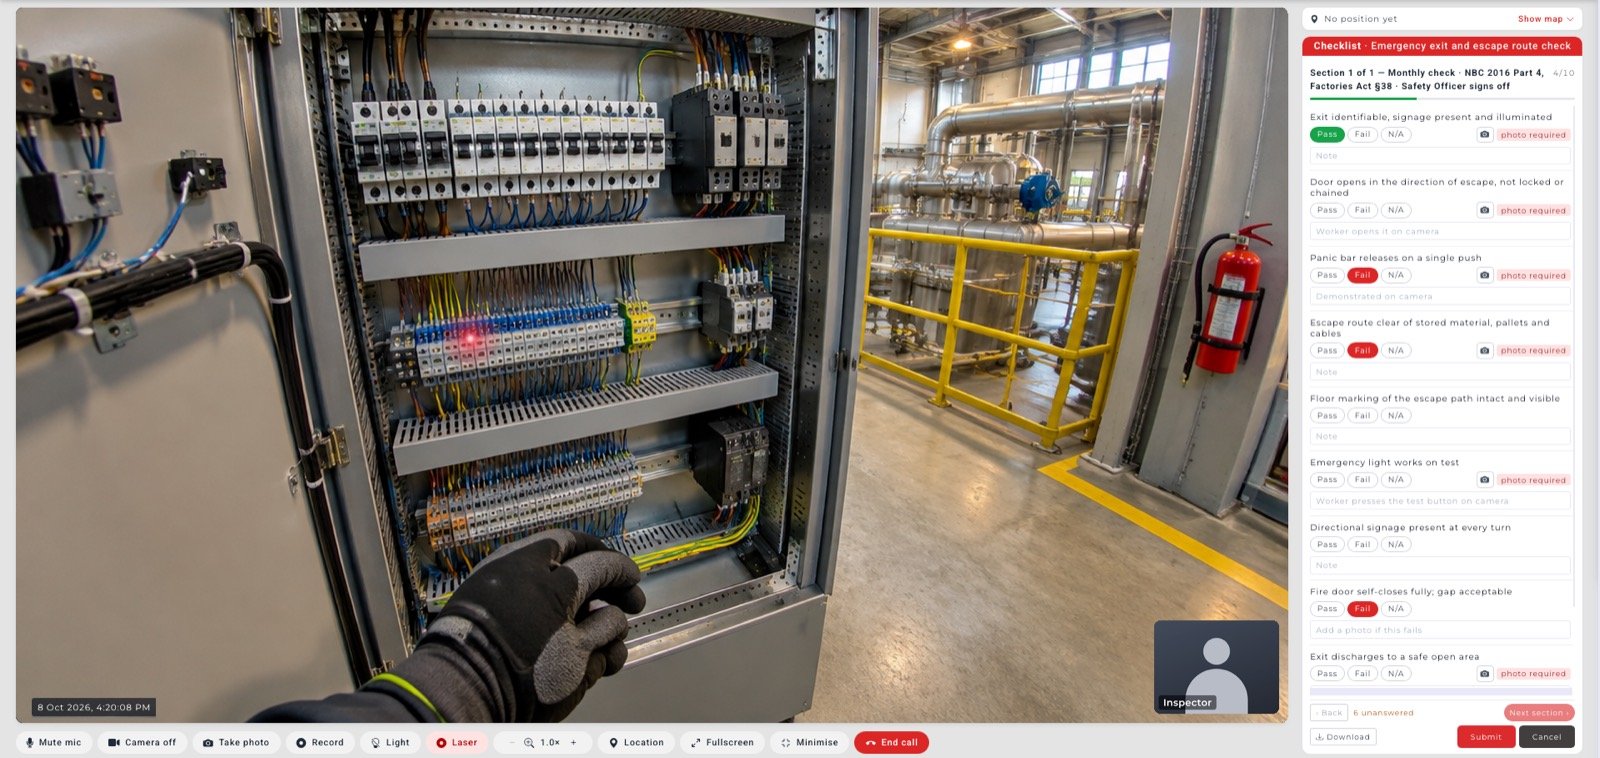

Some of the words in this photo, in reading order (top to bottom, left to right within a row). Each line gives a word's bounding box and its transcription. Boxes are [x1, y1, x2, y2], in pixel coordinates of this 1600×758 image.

[1324, 15, 1338, 23] No
[1340, 14, 1380, 24] position
[1382, 15, 1398, 25] yet
[1518, 14, 1542, 23] Show
[1544, 16, 1563, 24] map
[1313, 40, 1362, 51] Checklist
[1370, 40, 1427, 53] Emergency
[1429, 41, 1448, 51] exit
[1451, 41, 1470, 50] and
[1472, 42, 1509, 53] escape
[1511, 42, 1539, 51] route
[1541, 41, 1572, 50] check
[1310, 68, 1345, 77] Section
[1348, 68, 1353, 77] 1
[1356, 68, 1367, 77] of
[1369, 68, 1374, 77] 1
[1387, 68, 1426, 79] Monthly
[1427, 68, 1456, 77] check
[1464, 68, 1485, 77] NBC
[1487, 68, 1511, 77] 2016
[1513, 68, 1533, 77] Part
[1535, 68, 1544, 78] 4,
[1552, 68, 1575, 78] 4/10
[1310, 81, 1353, 91] Factories
[1355, 81, 1372, 90] Act
[1374, 82, 1393, 93] §38
[1401, 81, 1432, 92] Safety
[1433, 81, 1467, 90] Officer
[1469, 82, 1494, 92] signs
[1496, 81, 1511, 90] off
[1310, 112, 1329, 121] Exit
[1331, 112, 1390, 122] identifiable,
[1392, 112, 1432, 123] signage
[1434, 113, 1472, 123] present
[1474, 113, 1494, 121] and
[1496, 112, 1553, 121] illuminated
[1317, 130, 1338, 138] Pass
[1355, 130, 1371, 138] Fail
[1388, 130, 1405, 138] N/A
[1500, 131, 1527, 140] photo
[1529, 131, 1567, 140] required
[1310, 178, 1334, 186] Door
[1336, 179, 1367, 188] opens
[1369, 177, 1379, 186] in
[1381, 178, 1398, 186] the
[1400, 177, 1445, 186] direction
[1447, 177, 1458, 186] of
[1459, 179, 1497, 188] escape,
[1499, 178, 1516, 186] not
[1519, 177, 1551, 186] locked
[1309, 188, 1349, 197] chained
[1500, 207, 1527, 216] photo
[1529, 207, 1567, 216] required
[1310, 253, 1338, 262] Panic
[1340, 253, 1356, 262] bar
[1359, 253, 1399, 262] releases
[1425, 253, 1455, 264] single
[1457, 253, 1482, 264] push
[1317, 271, 1338, 279] Pass
[1355, 271, 1371, 279] Fail
[1388, 271, 1405, 279] N/A
[1500, 272, 1527, 281] photo
[1529, 271, 1567, 281] required
[1310, 318, 1345, 329] Escape
[1347, 319, 1374, 327] route
[1376, 318, 1400, 327] clear
[1402, 317, 1413, 327] of
[1415, 318, 1447, 327] stored
[1449, 318, 1493, 328] material,
[1495, 318, 1529, 328] pallets
[1531, 318, 1550, 327] and
[1309, 329, 1342, 338] cables
[1317, 346, 1338, 355] Pass
[1355, 346, 1371, 355] Fail
[1388, 346, 1405, 355] N/A
[1500, 346, 1527, 356] photo
[1529, 346, 1567, 356] required
[1310, 394, 1335, 403] Floor
[1337, 394, 1379, 405] marking
[1381, 393, 1392, 403] of
[1394, 394, 1411, 403] the
[1413, 395, 1448, 404] escape
[1450, 394, 1474, 404] path
[1476, 394, 1505, 403] intact
[1507, 394, 1526, 403] and
[1528, 394, 1561, 403] visible
[1310, 458, 1366, 468] Emergency
[1368, 458, 1391, 468] light
[1393, 458, 1423, 467] works
[1425, 459, 1438, 467] on
[1440, 459, 1460, 467] test
[1500, 476, 1527, 486] photo
[1529, 476, 1567, 486] required
[1310, 523, 1364, 532] Directional
[1366, 524, 1406, 534] signage
[1408, 524, 1446, 533] present
[1448, 524, 1459, 532] at
[1461, 524, 1488, 533] every
[1490, 524, 1512, 532] turn
[1310, 587, 1329, 596] Fire
[1331, 587, 1354, 596] door
[1356, 587, 1408, 596] self-closes
[1410, 587, 1435, 598] fully;
[1436, 588, 1456, 597] gap
[1458, 587, 1513, 597] acceptable
[1317, 604, 1338, 613] Pass
[1355, 604, 1371, 613] Fail
[1388, 604, 1405, 613] N/A
[1310, 652, 1329, 661] Exit
[1330, 652, 1385, 663] discharges
[1387, 653, 1398, 661] to
[1408, 652, 1429, 661] safe
[1430, 654, 1456, 662] open
[1317, 669, 1338, 678] Pass
[1355, 669, 1371, 678] Fail
[1388, 669, 1405, 678] N/A
[1500, 669, 1527, 679] photo
[1529, 669, 1567, 679] required
[1353, 709, 1359, 717] 6
[1360, 709, 1414, 717] unanswered
[1508, 708, 1529, 717] Next
[1531, 708, 1564, 717] section
[1326, 733, 1370, 741] Download
[1469, 733, 1503, 741] Submit
[1531, 733, 1562, 741] Cancel
[38, 738, 63, 747] Mute
[64, 738, 82, 747] mic
[125, 738, 160, 747] Camera
[162, 737, 177, 747] off
[218, 738, 241, 747] Take
[242, 738, 270, 748] photo
[311, 738, 344, 747] Record
[386, 737, 410, 749] Light
[451, 738, 478, 747] Laser
[624, 738, 664, 747] Location
[706, 738, 754, 747] Fullscreen
[796, 738, 839, 747] Minimise
[881, 737, 899, 747] End
[900, 737, 918, 747] call
